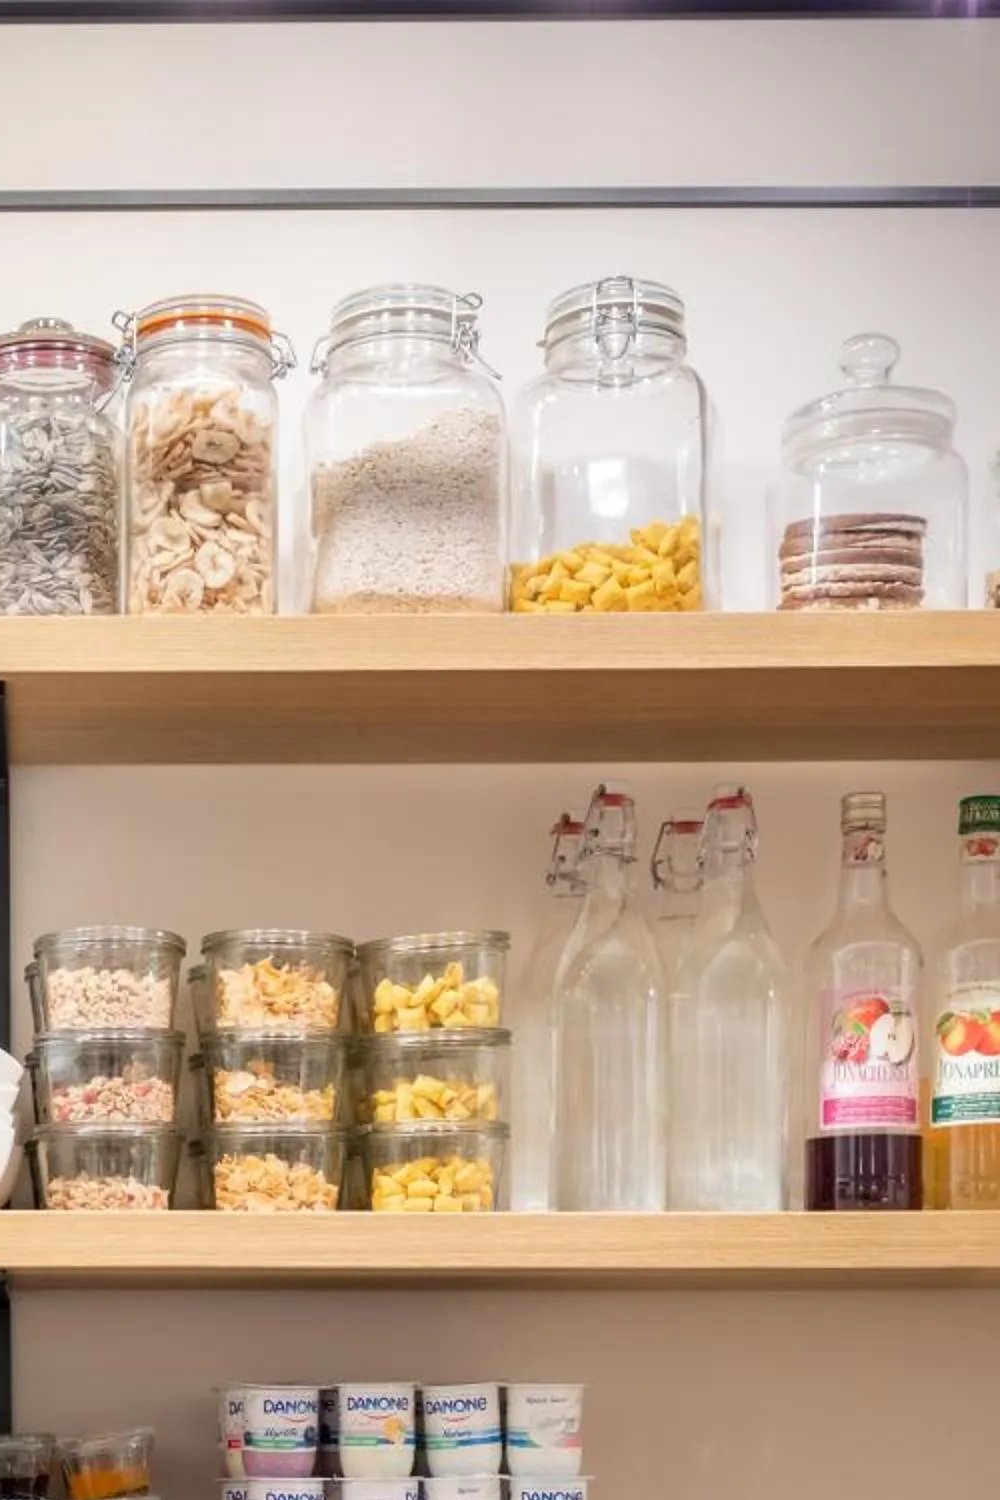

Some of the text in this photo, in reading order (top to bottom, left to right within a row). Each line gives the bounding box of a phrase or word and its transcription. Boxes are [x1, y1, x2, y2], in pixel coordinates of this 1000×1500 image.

[263, 1399, 319, 1414] DANON
[347, 1397, 409, 1411] DANONE
[425, 1397, 488, 1415] DANONE
